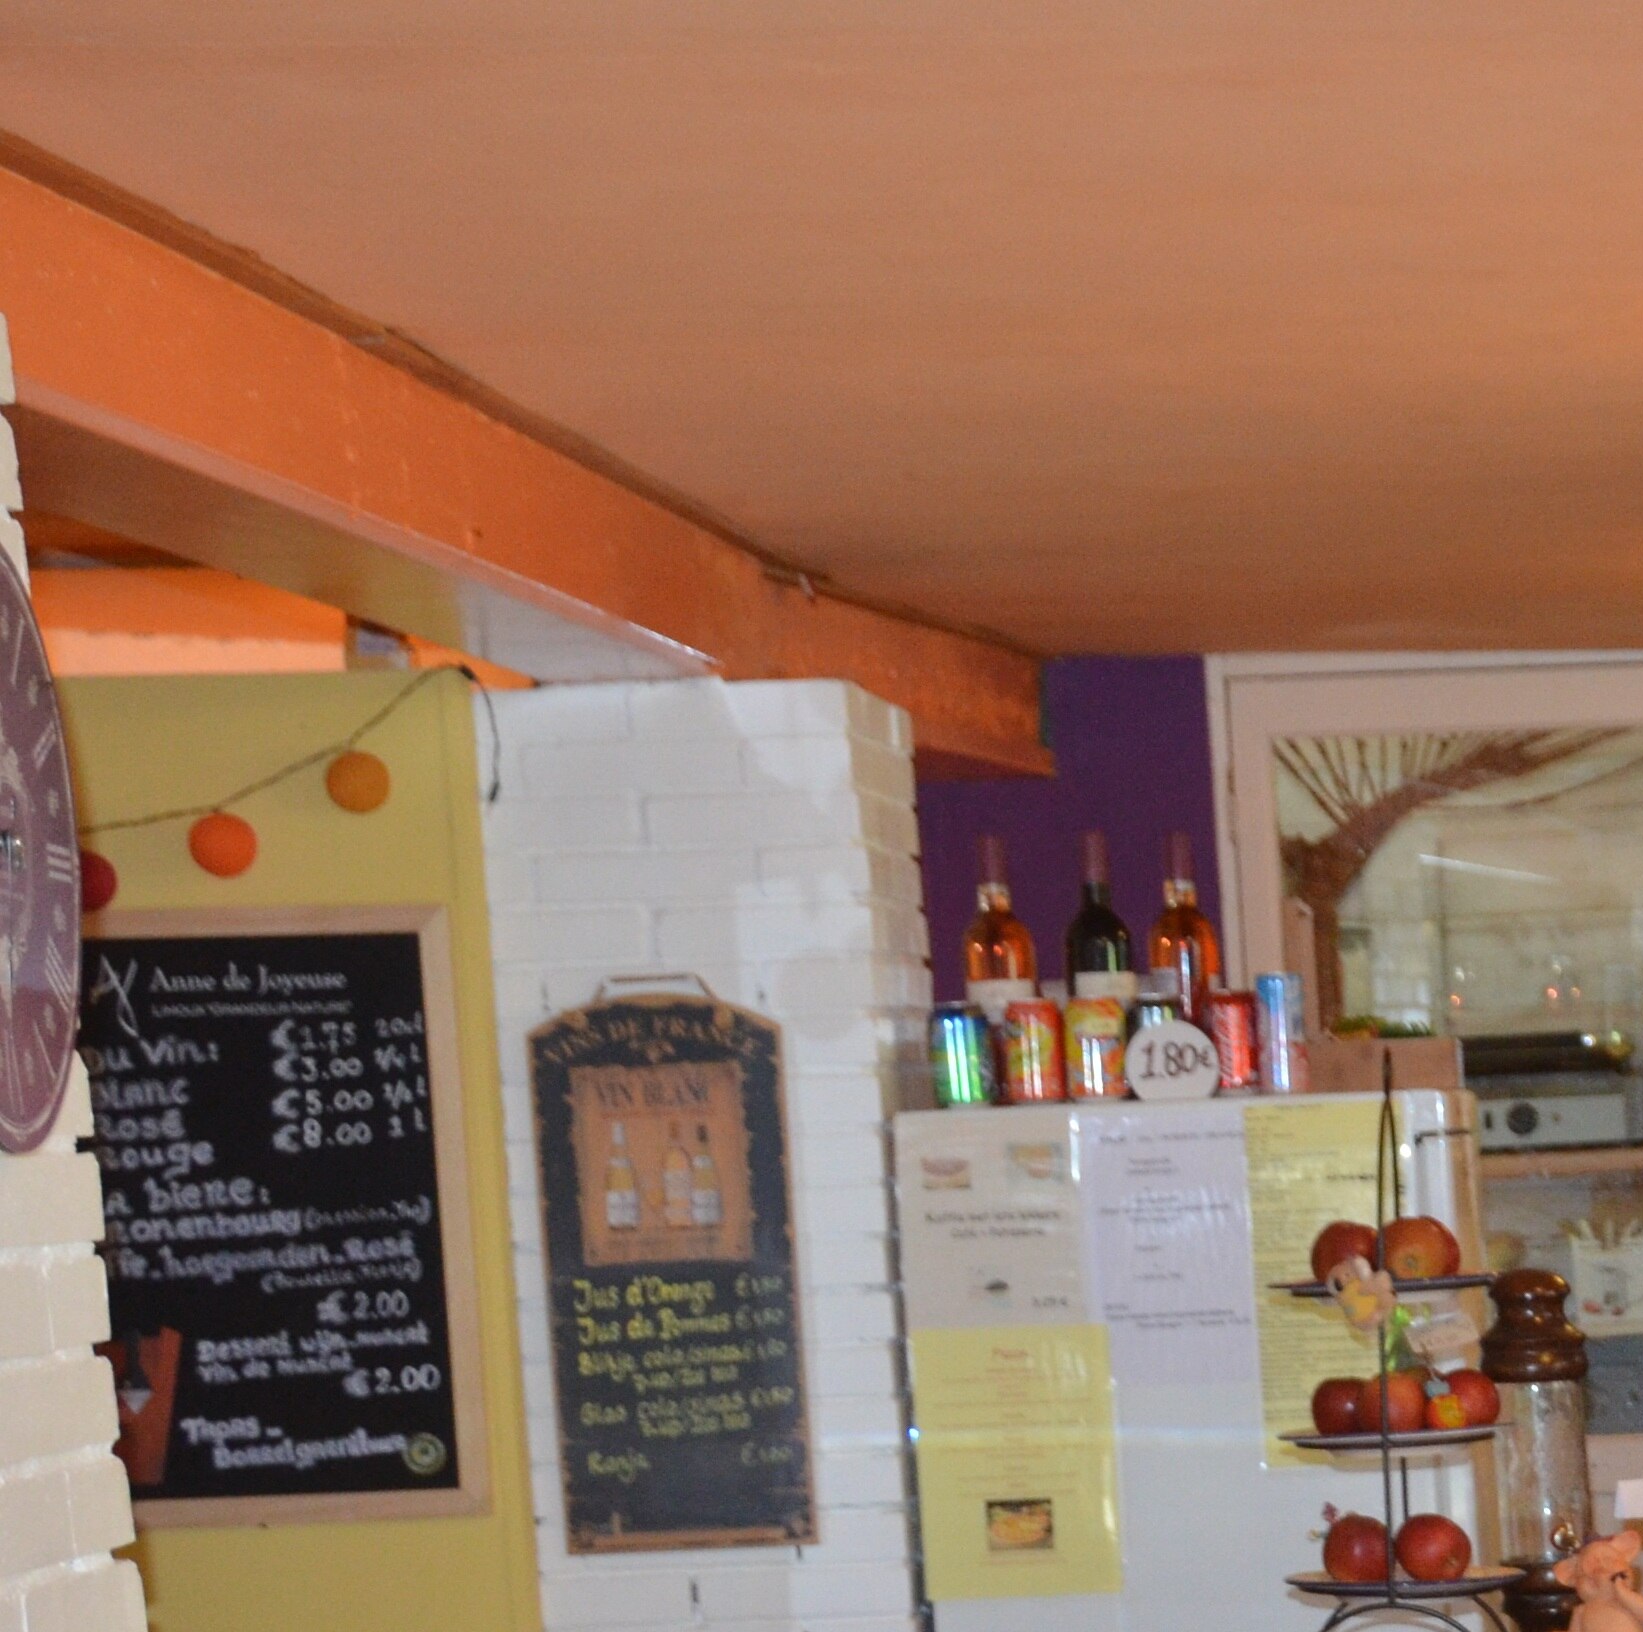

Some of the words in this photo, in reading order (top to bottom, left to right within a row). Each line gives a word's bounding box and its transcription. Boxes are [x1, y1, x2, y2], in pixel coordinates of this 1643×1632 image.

[151, 966, 217, 992] Anne
[223, 960, 250, 992] de
[259, 963, 348, 995] Joyeuse
